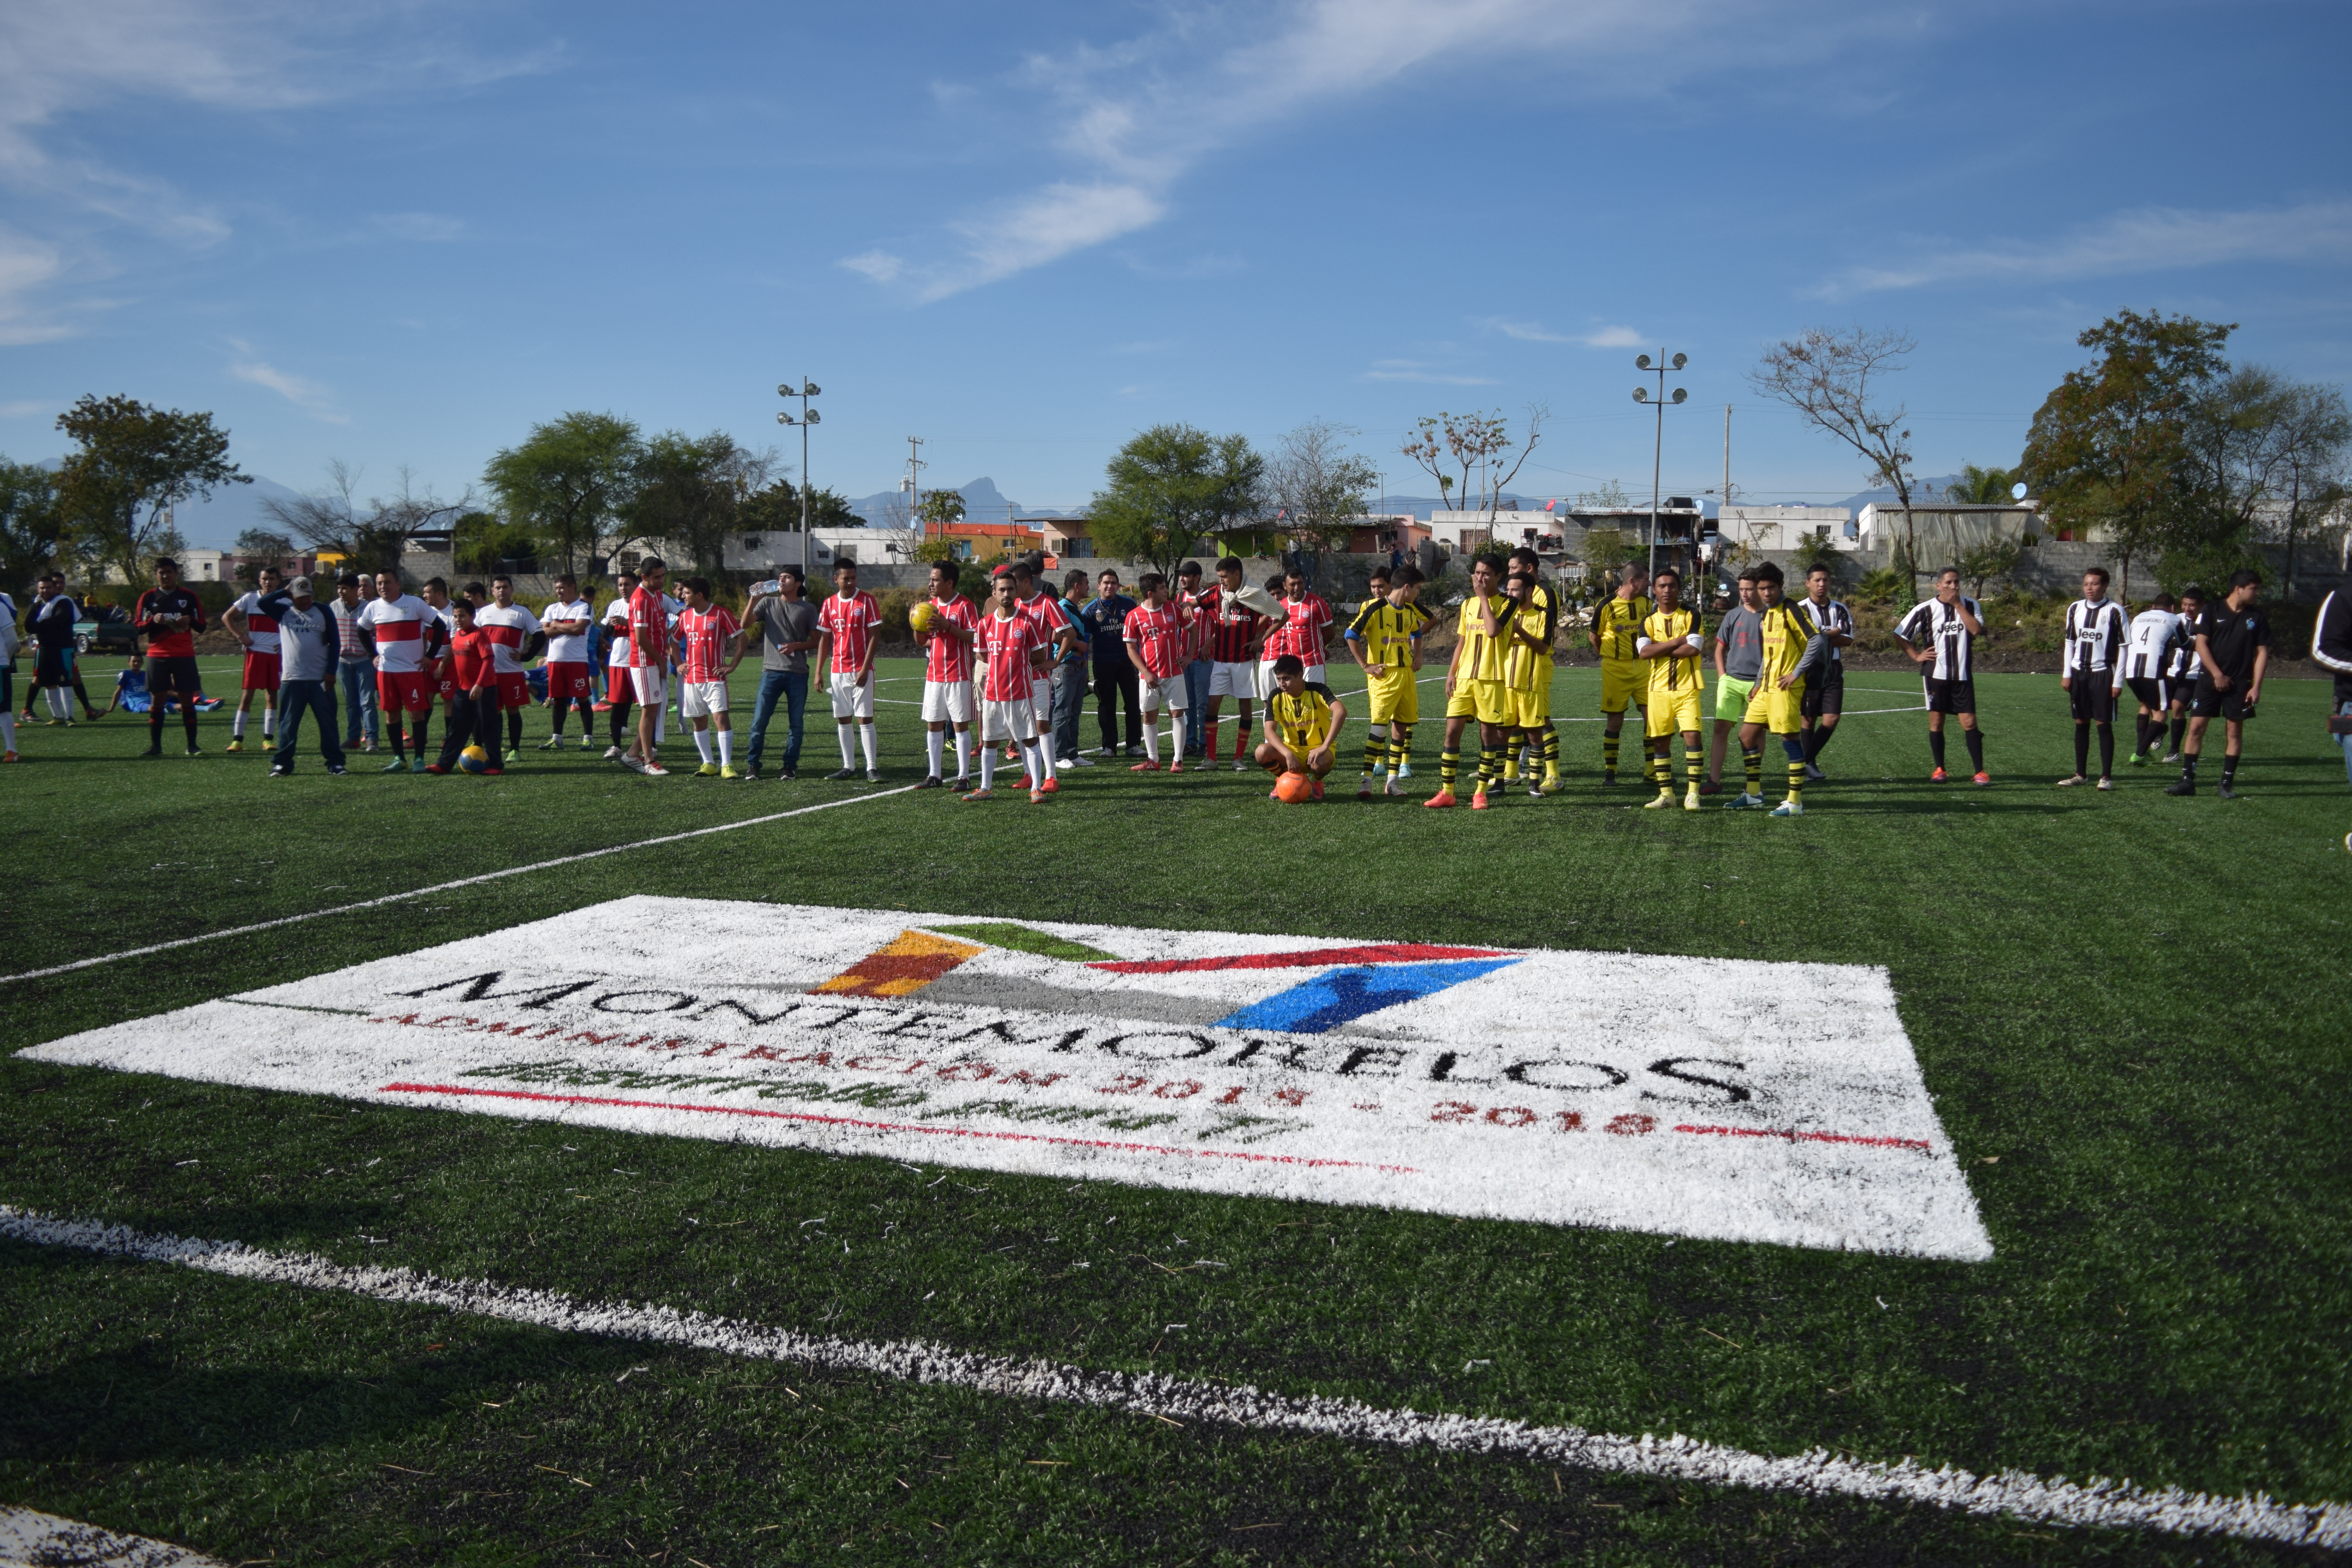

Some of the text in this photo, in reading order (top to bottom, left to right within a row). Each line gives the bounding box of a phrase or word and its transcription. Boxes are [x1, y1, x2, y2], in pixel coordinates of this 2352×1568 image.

[1220, 613, 1251, 621] Eirates
[1100, 623, 1125, 632] Emirate
[1937, 623, 1964, 633] Jeep
[2078, 628, 2103, 642] Jeep
[2140, 626, 2151, 645] 4
[441, 681, 450, 690] 22
[575, 678, 585, 688] 29
[412, 689, 418, 699] 4
[514, 686, 519, 696] 7
[385, 971, 1764, 1112] MONTEMORELOS
[1428, 1098, 1660, 1136] 2018
